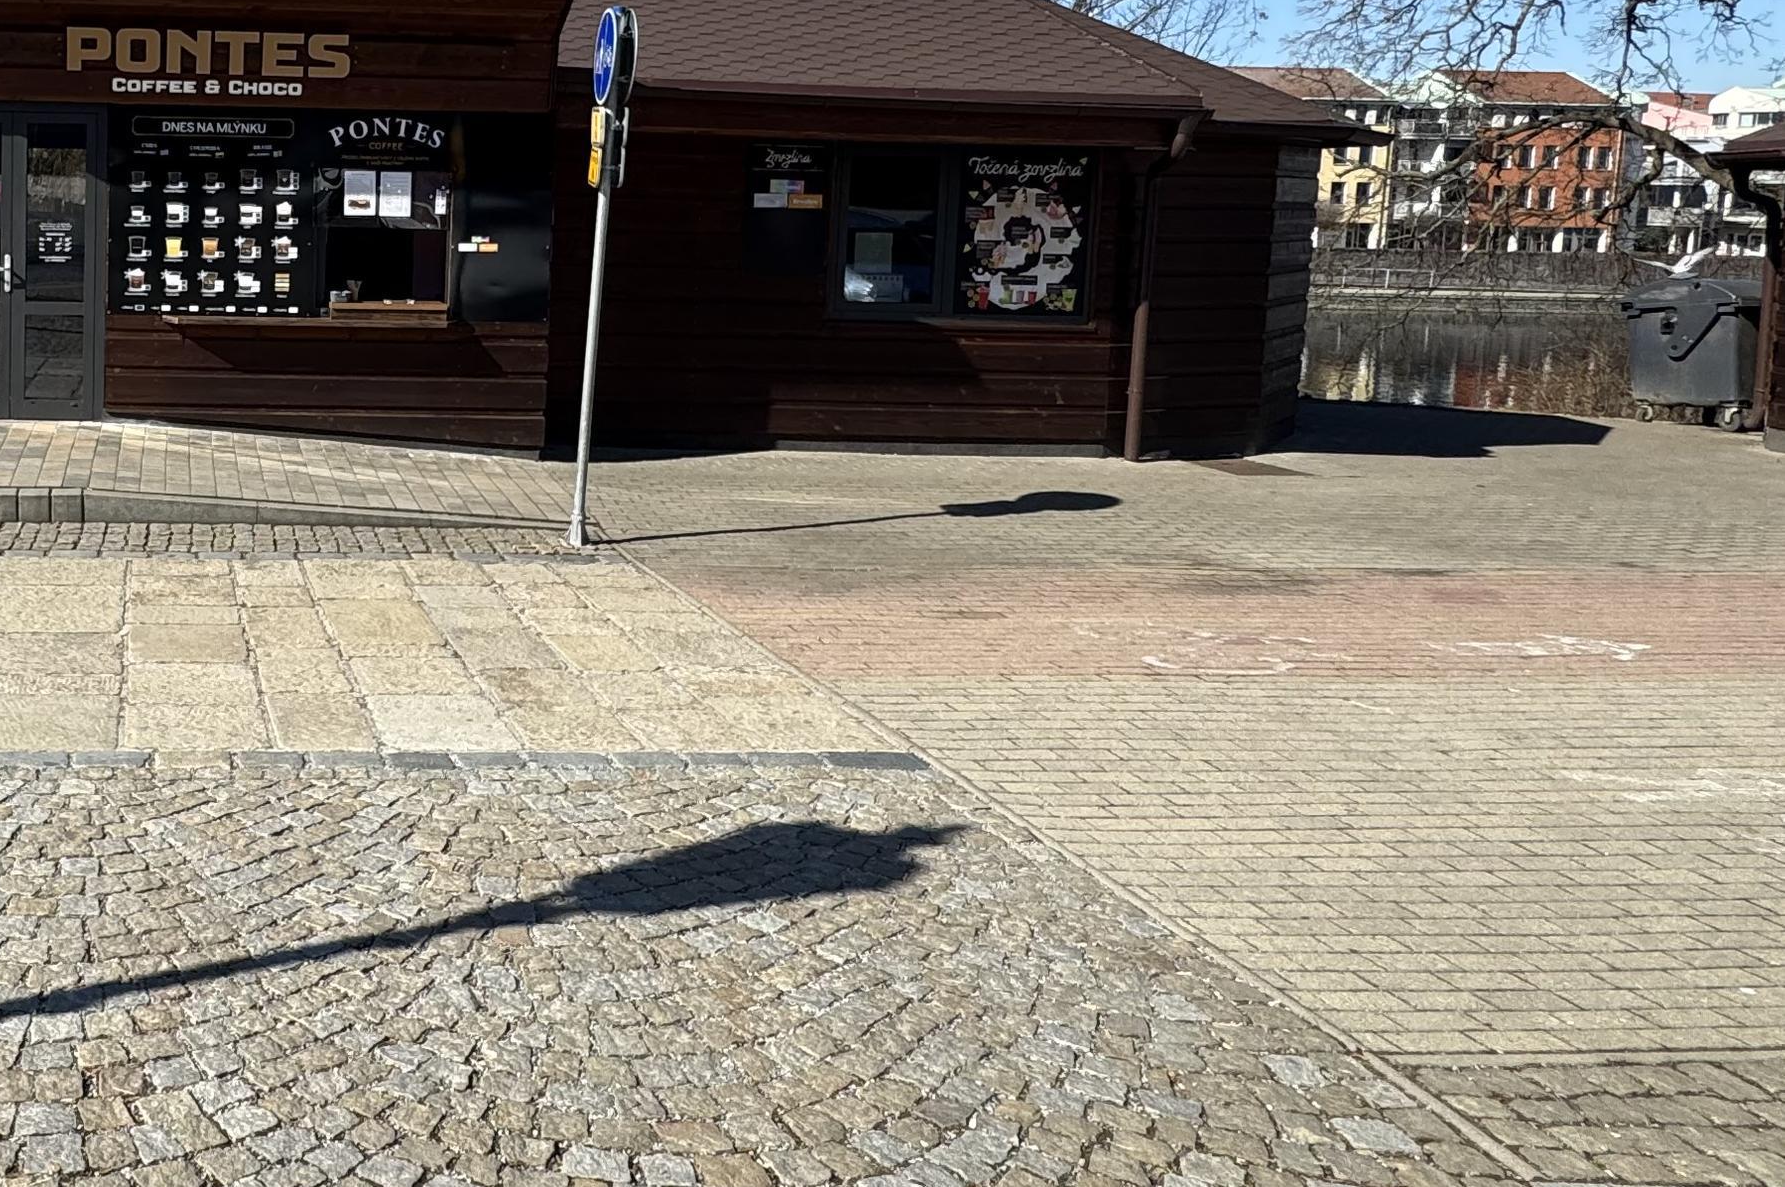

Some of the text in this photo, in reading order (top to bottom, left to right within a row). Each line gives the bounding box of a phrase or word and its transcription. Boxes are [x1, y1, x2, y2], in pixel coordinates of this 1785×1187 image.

[66, 26, 351, 78] PONTES
[112, 77, 303, 96] COFFEE & CHOCO
[162, 120, 267, 134] DNES NA MLÝNKU
[328, 117, 445, 148] PONTES
[368, 141, 404, 151] COFFEE
[968, 155, 1084, 183] Točená zmrzlina
